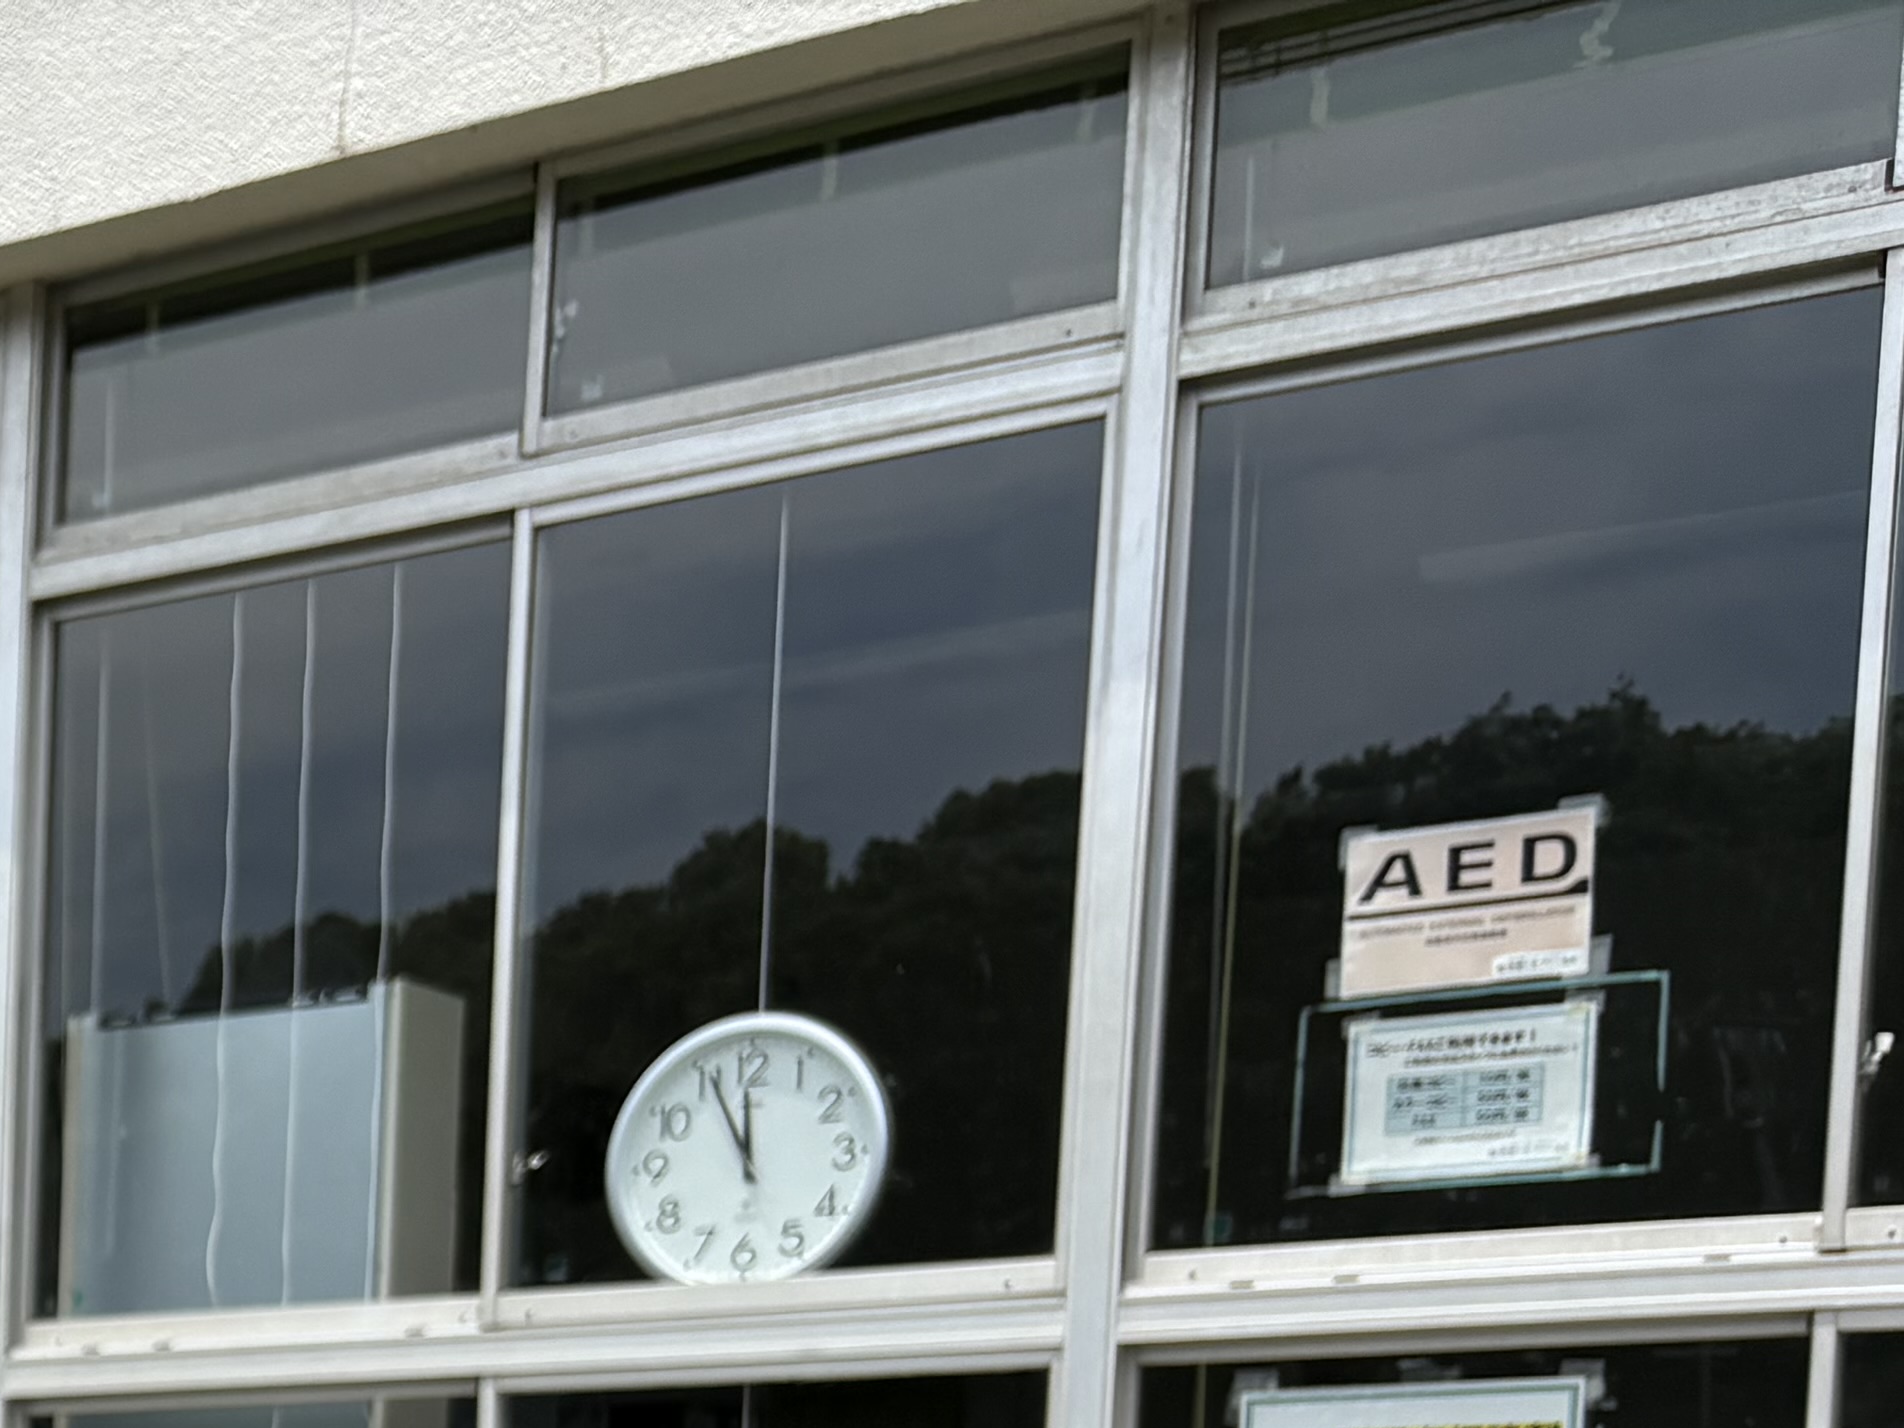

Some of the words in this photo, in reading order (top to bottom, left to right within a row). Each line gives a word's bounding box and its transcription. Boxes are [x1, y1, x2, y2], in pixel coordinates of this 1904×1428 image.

[1357, 831, 1578, 904] AED
[697, 1061, 722, 1102] 11
[736, 1049, 770, 1090] 12
[658, 1102, 691, 1142] 10
[817, 1083, 843, 1125] 2
[641, 1149, 669, 1189] 9
[831, 1131, 857, 1172] 3
[655, 1193, 681, 1235] 8
[813, 1183, 837, 1217] 4
[693, 1224, 718, 1264] 7
[730, 1232, 757, 1272] 6
[777, 1218, 806, 1259] 5
